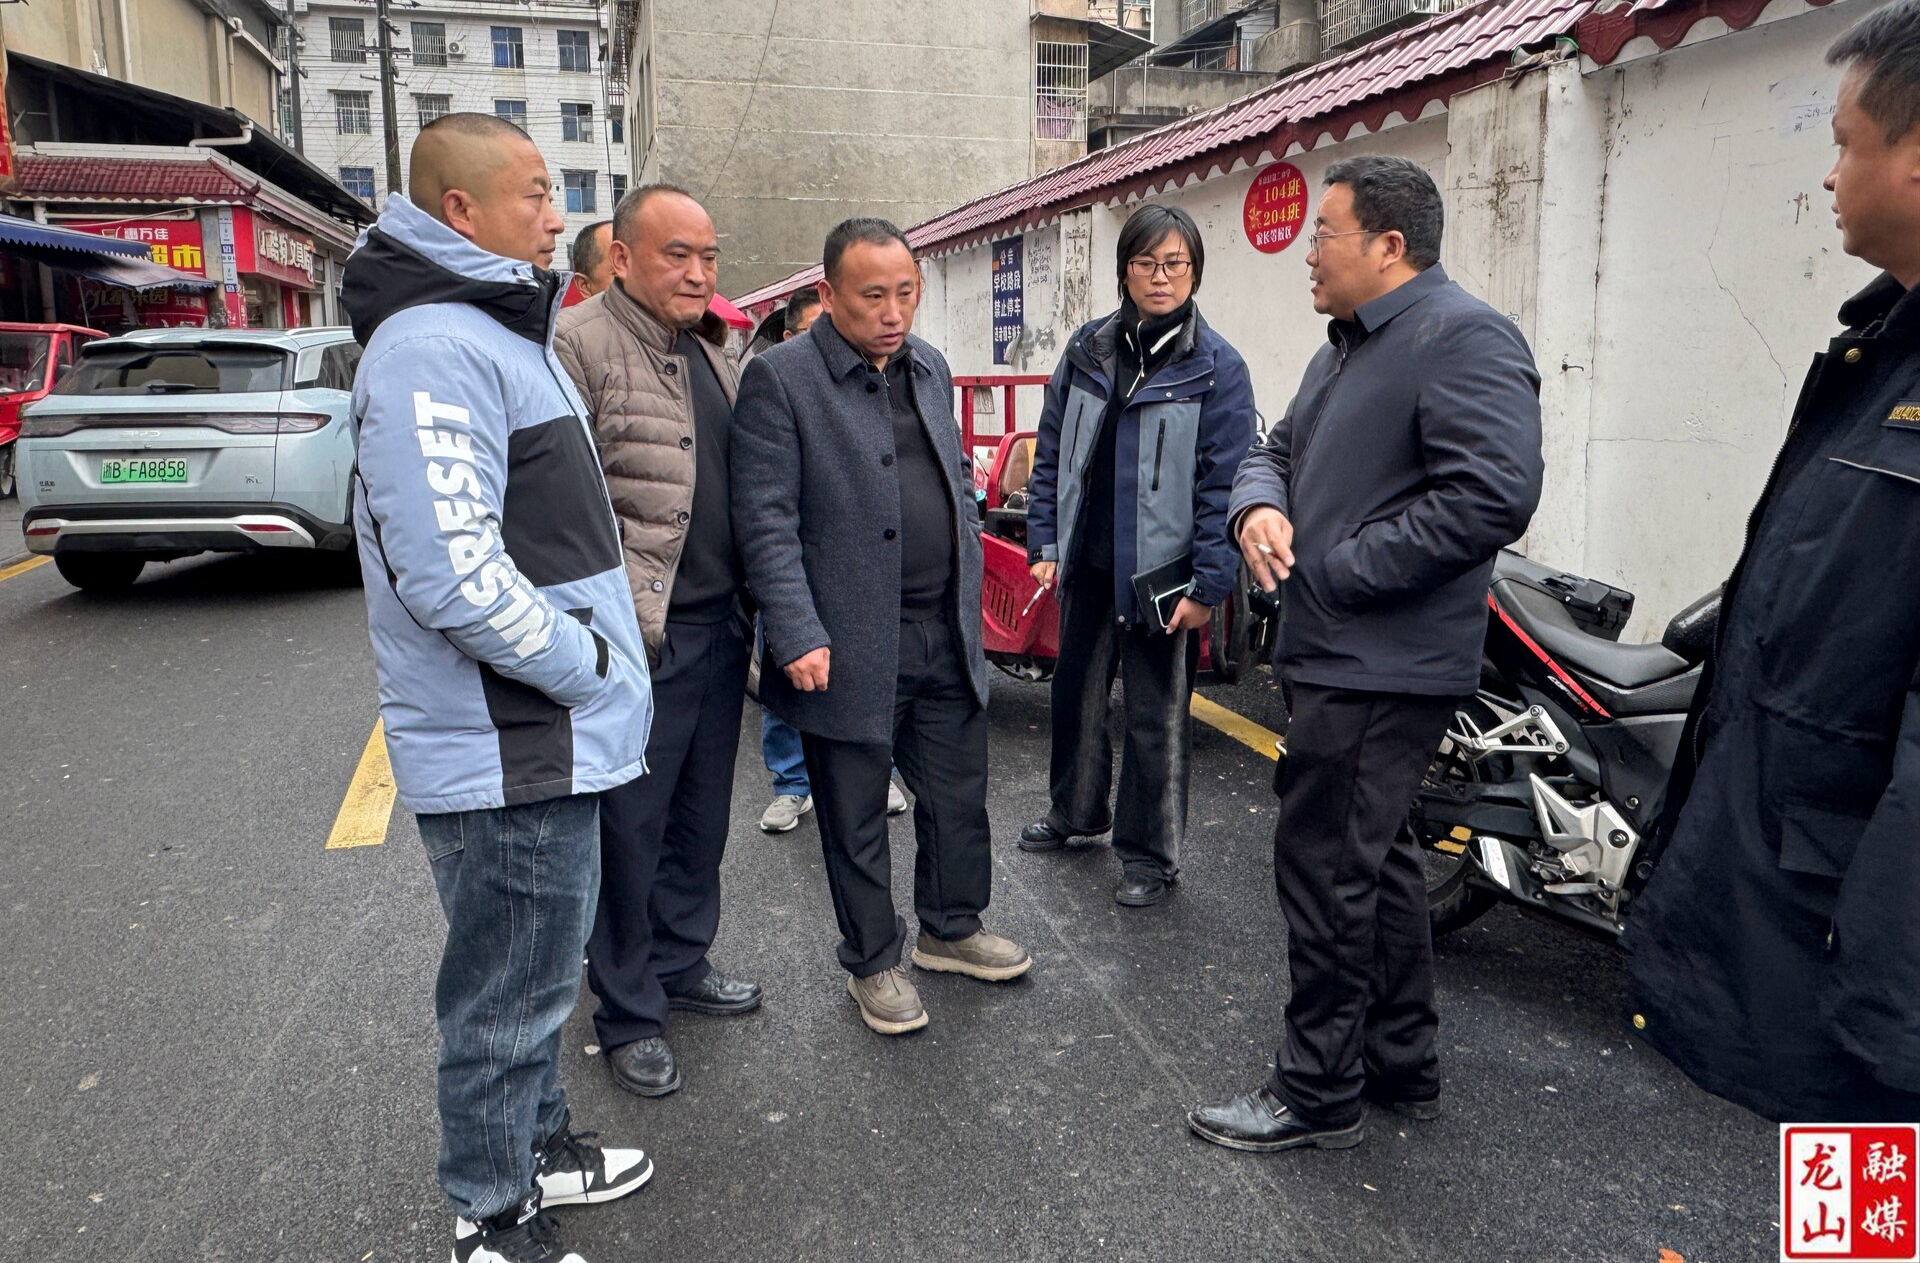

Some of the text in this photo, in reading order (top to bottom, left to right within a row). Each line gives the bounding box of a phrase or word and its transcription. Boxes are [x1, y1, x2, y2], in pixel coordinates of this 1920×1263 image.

[1263, 177, 1301, 204] 104班
[1263, 202, 1300, 227] 204班
[993, 270, 1021, 293] 学校路段
[993, 296, 1022, 318] 禁止停车
